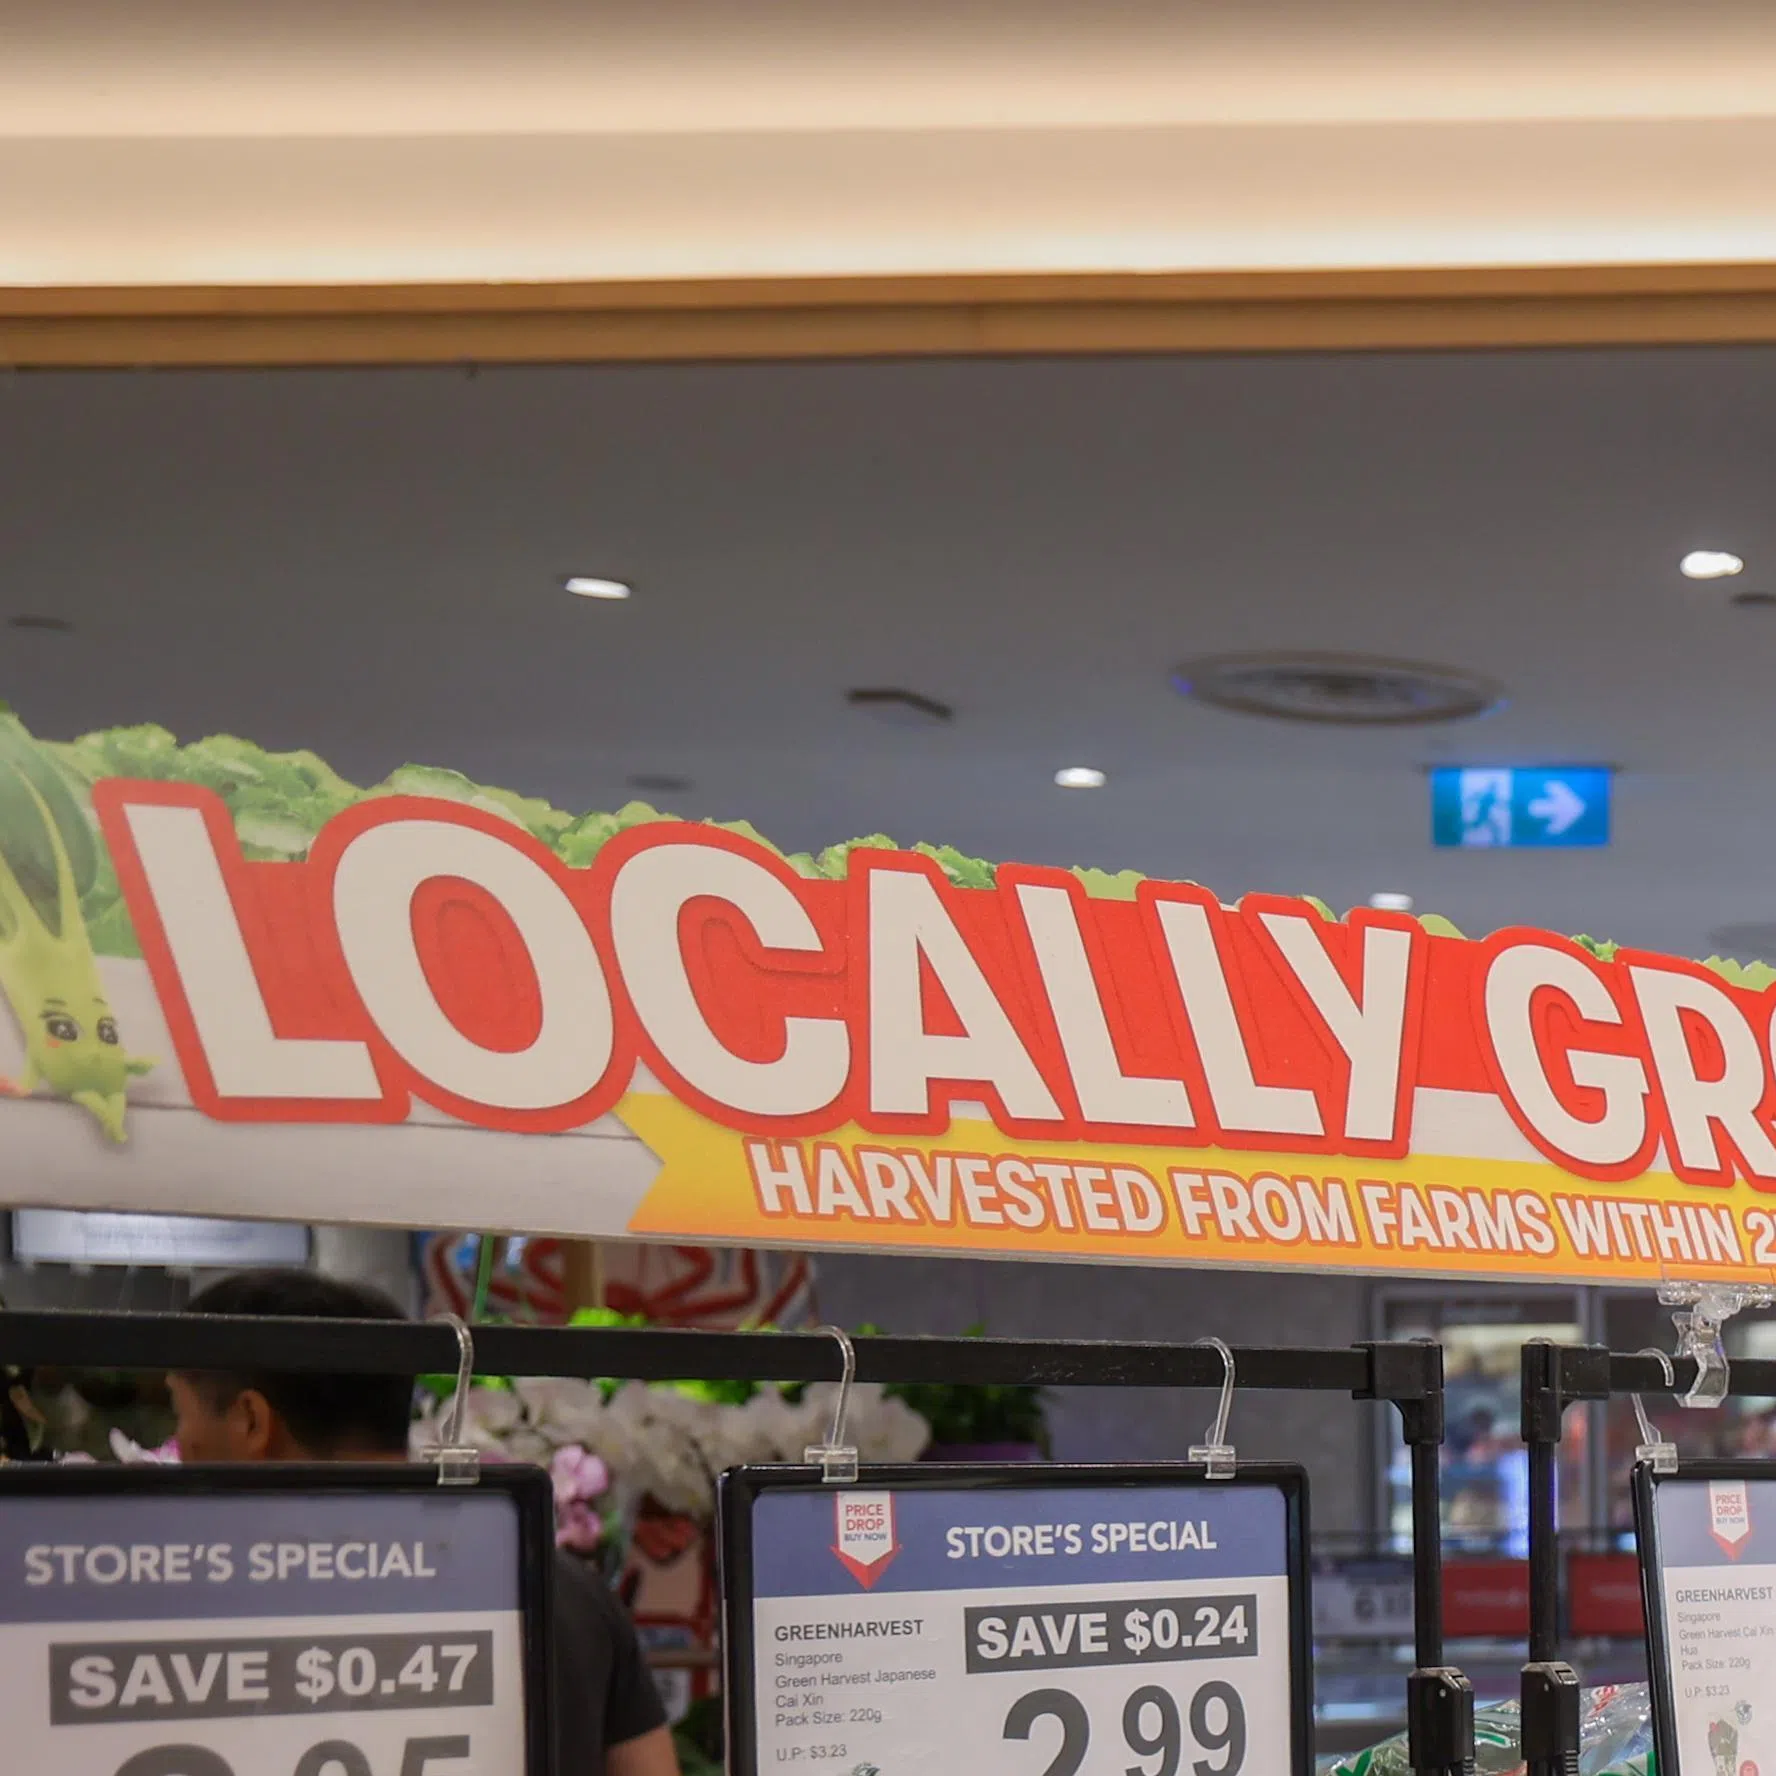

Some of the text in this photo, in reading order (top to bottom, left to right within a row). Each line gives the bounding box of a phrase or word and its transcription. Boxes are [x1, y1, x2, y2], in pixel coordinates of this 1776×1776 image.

[122, 803, 1415, 1140] LOCALLY
[755, 1142, 1163, 1234] HARVESTED
[1176, 1164, 1353, 1244] FROM
[1366, 1186, 1552, 1258] FARMS
[1556, 1196, 1741, 1266] WITHIN
[1715, 1494, 1741, 1505] PRICE
[845, 1503, 884, 1517] PRICE
[1716, 1506, 1743, 1517] DROP
[845, 1518, 885, 1531] DROP
[844, 1532, 887, 1542] BUY NOW
[946, 1520, 1217, 1559] STORE'S SPECIAL
[24, 1540, 436, 1585] STORE'S SPECIAL
[1676, 1586, 1773, 1604] GREENHARVEST
[1677, 1612, 1721, 1625] Singapore
[774, 1618, 924, 1642] GREENHARVEST
[976, 1604, 1250, 1661] SAVE $0.24
[1679, 1628, 1706, 1641] Green
[1708, 1626, 1741, 1640] Harvest
[1680, 1644, 1698, 1657] Hua
[775, 1652, 843, 1669] Singapore
[1682, 1658, 1703, 1671] Pack
[68, 1643, 479, 1709] SAVE $0.47
[775, 1667, 936, 1689] Green Harvest Japanese
[775, 1693, 824, 1709] Cai Xin
[775, 1708, 882, 1727] Pack Size: 220g
[810, 1743, 848, 1760] $3.23
